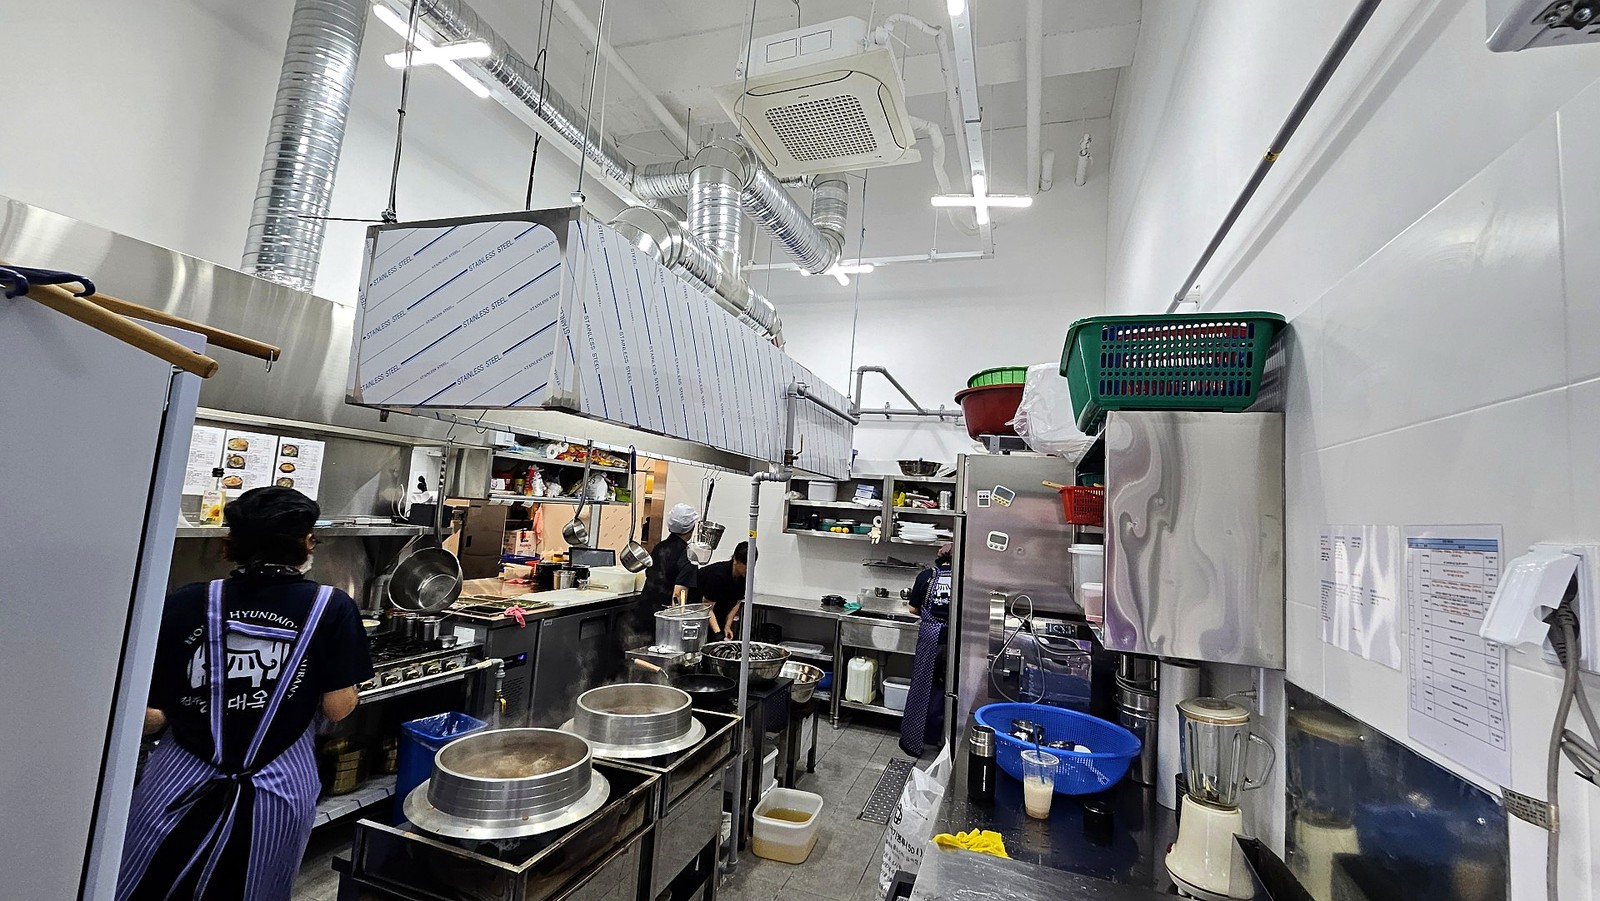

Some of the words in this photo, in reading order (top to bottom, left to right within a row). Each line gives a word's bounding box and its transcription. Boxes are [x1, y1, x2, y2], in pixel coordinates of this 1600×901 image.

[373, 266, 397, 286] STAINLESS
[398, 256, 413, 269] STEEL
[468, 250, 496, 272] STAINLESS
[496, 240, 514, 253] STEEL
[366, 320, 391, 340] STAINLESS
[392, 310, 407, 322] STEEL
[462, 306, 491, 328] STAINLESS
[491, 296, 508, 310] STEEL
[584, 315, 596, 350] STAINLESS
[385, 365, 400, 377] STEEL
[456, 364, 484, 386] STAINLESS
[485, 354, 502, 368] STEEL
